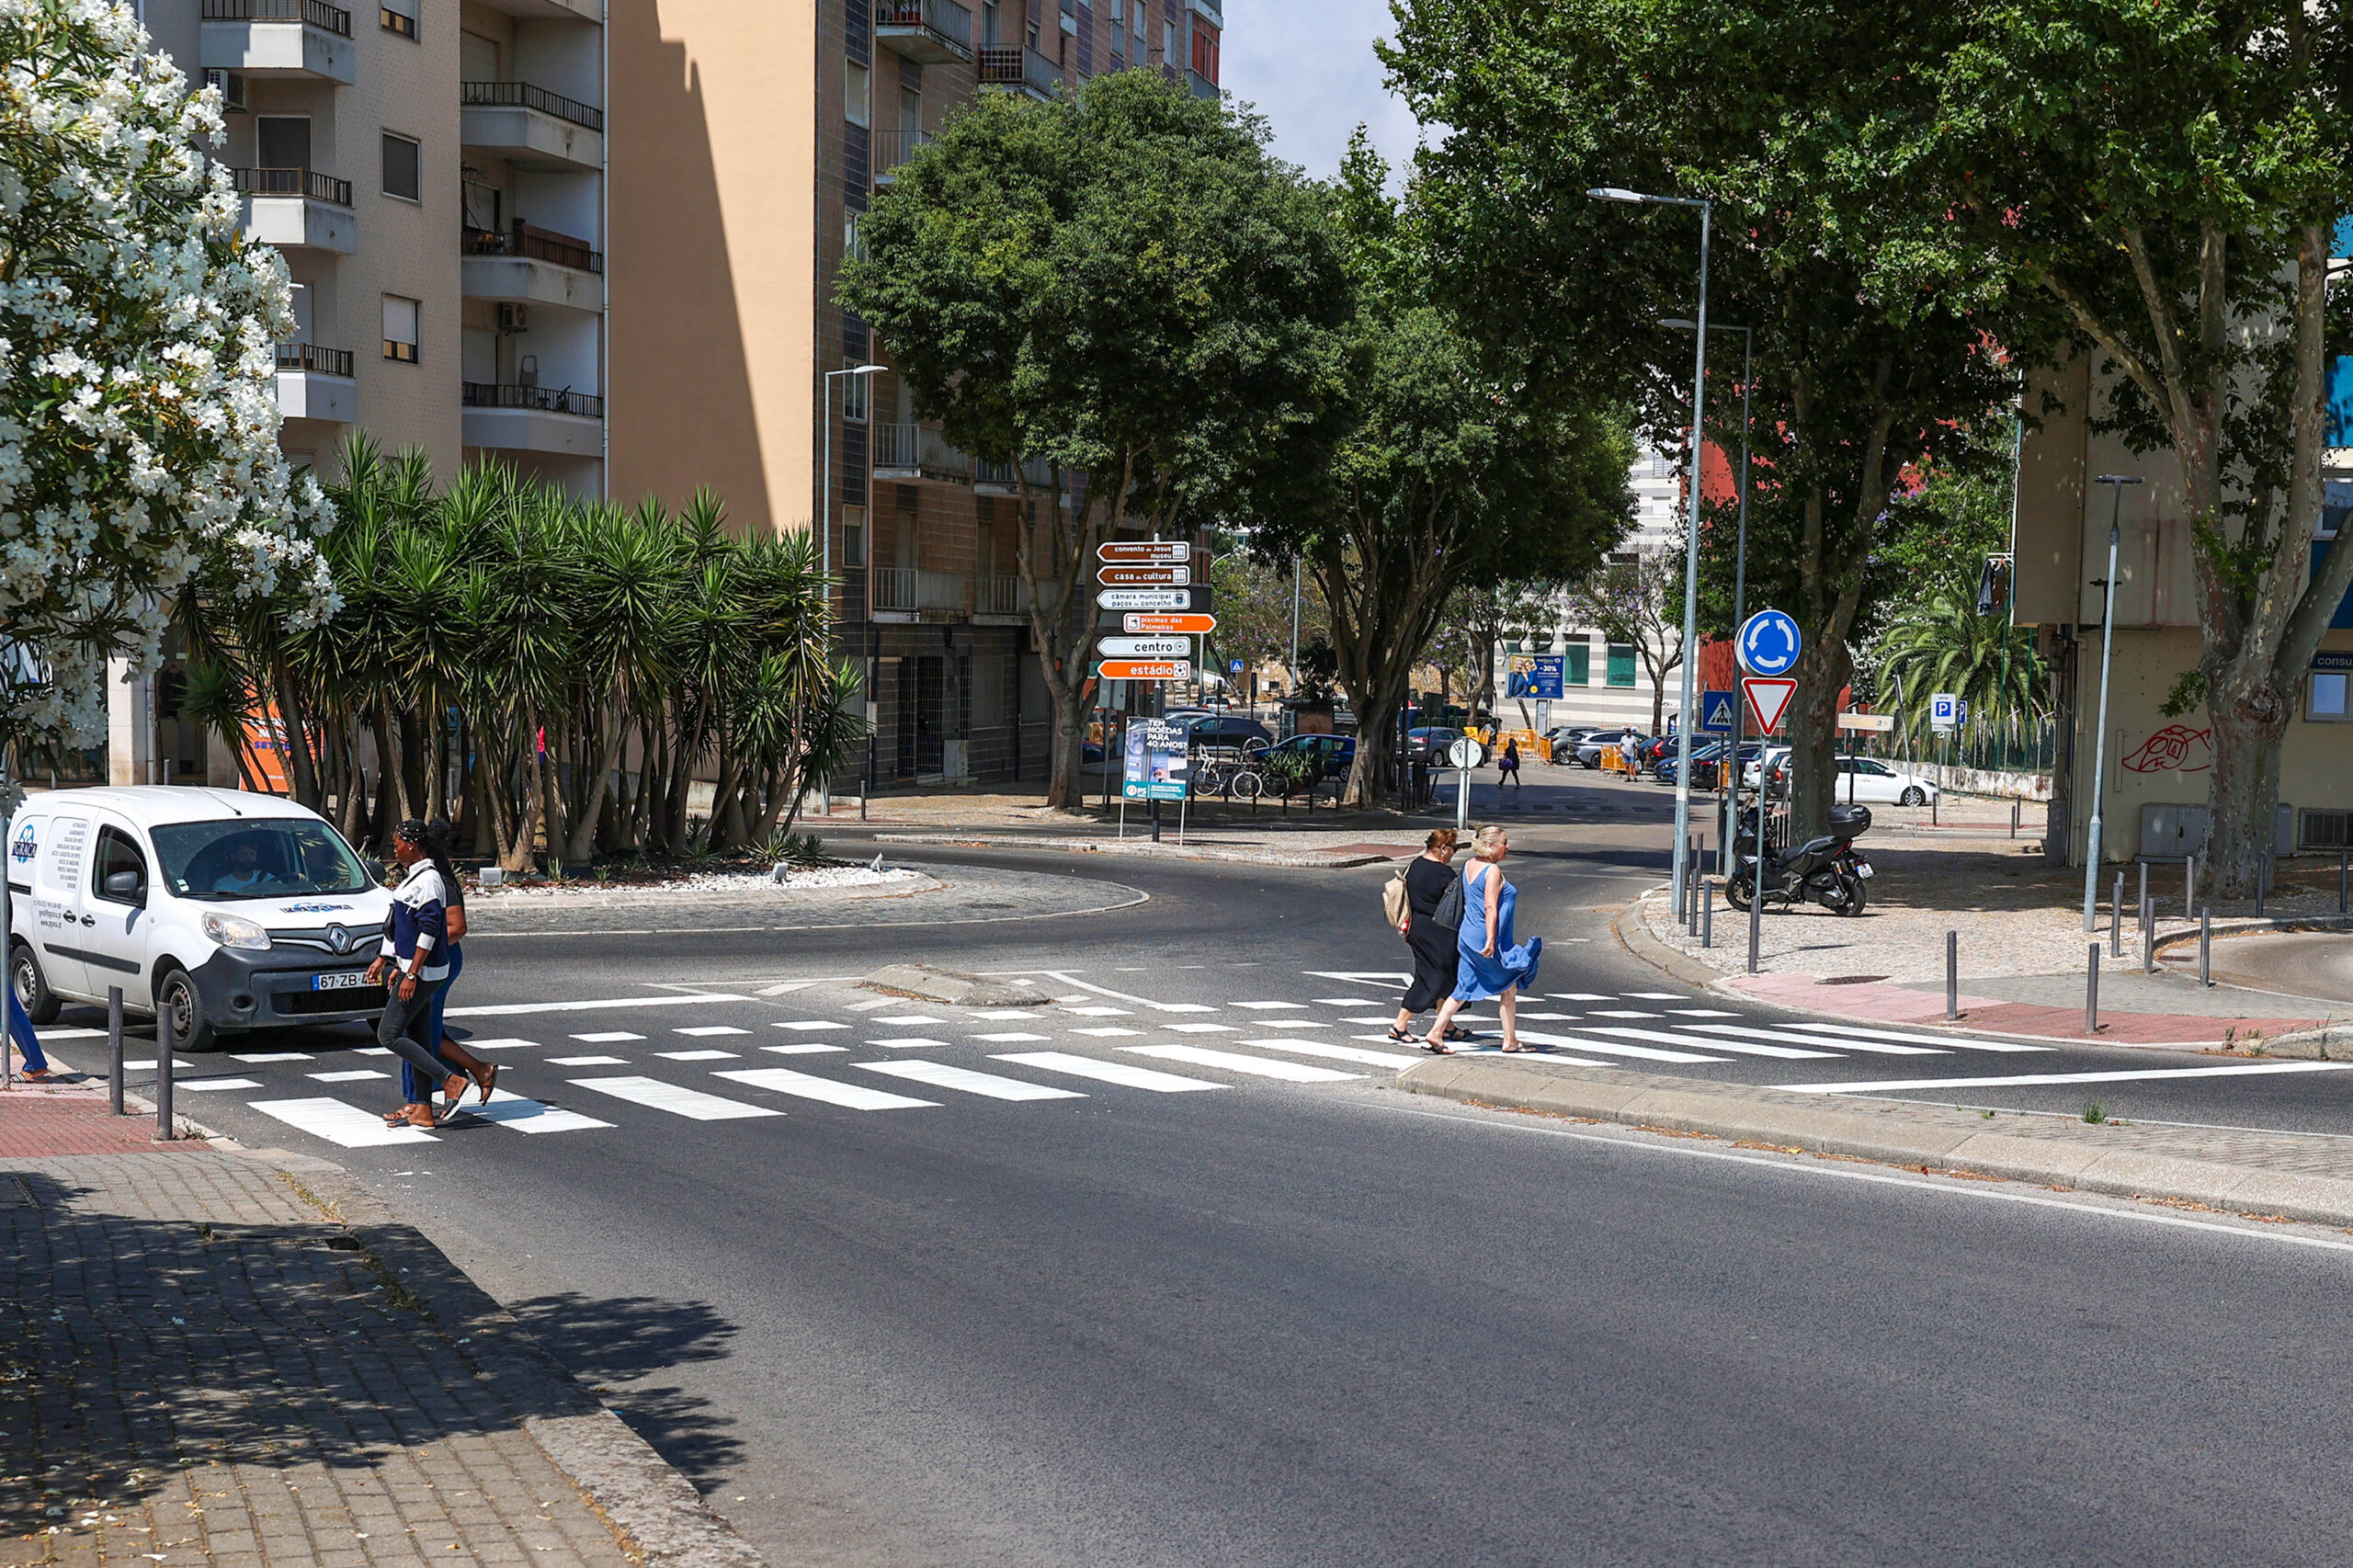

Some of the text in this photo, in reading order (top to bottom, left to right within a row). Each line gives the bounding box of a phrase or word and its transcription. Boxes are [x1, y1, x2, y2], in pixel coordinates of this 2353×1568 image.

[1142, 572, 1172, 580] cultura
[1140, 593, 1172, 601] municipal
[1134, 642, 1173, 652] centro
[2317, 657, 2353, 666] consu
[1131, 665, 1174, 676] estádio
[1938, 702, 1949, 716] P
[1147, 727, 1183, 735] MOEDAS
